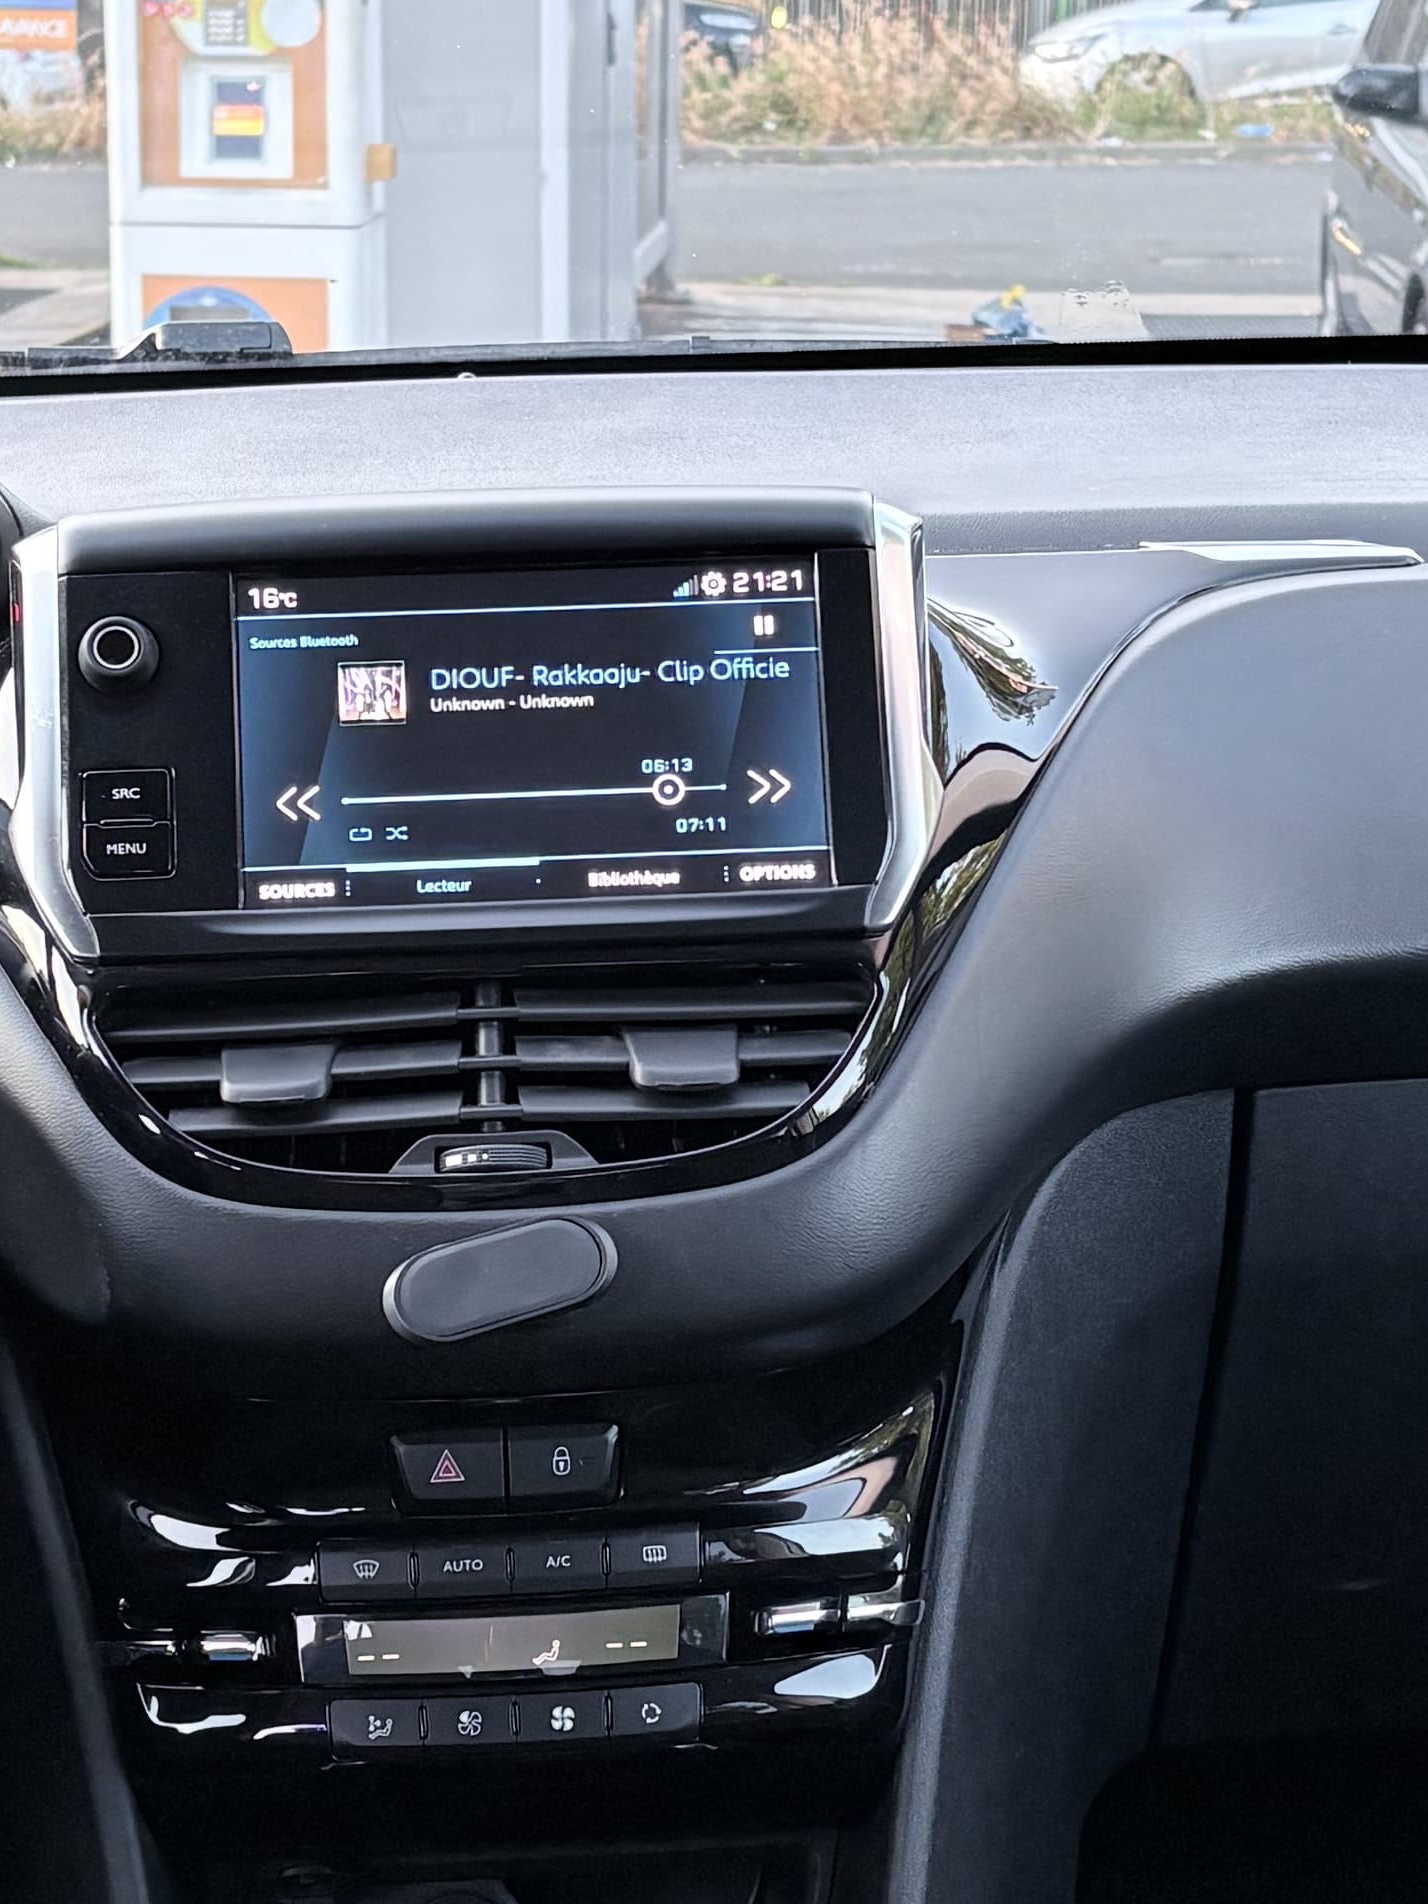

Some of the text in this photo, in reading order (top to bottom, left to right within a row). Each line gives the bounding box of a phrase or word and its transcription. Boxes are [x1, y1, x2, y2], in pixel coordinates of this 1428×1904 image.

[732, 569, 803, 593] 21:21
[249, 634, 359, 650] Sources Bluetooth
[430, 657, 790, 690] DIOUF- Rakkaaju- Clip Officie
[430, 697, 505, 713] Unknown
[520, 693, 594, 709] Unknown
[641, 757, 693, 774] 06:13
[111, 787, 141, 800] SRC
[675, 816, 727, 833] 07:11
[106, 842, 147, 855] MENU
[258, 863, 816, 900] SOURCES Lecteur Bibliothèque OPTIONS
[443, 1559, 484, 1573] AUTO
[546, 1555, 571, 1568] A/C
